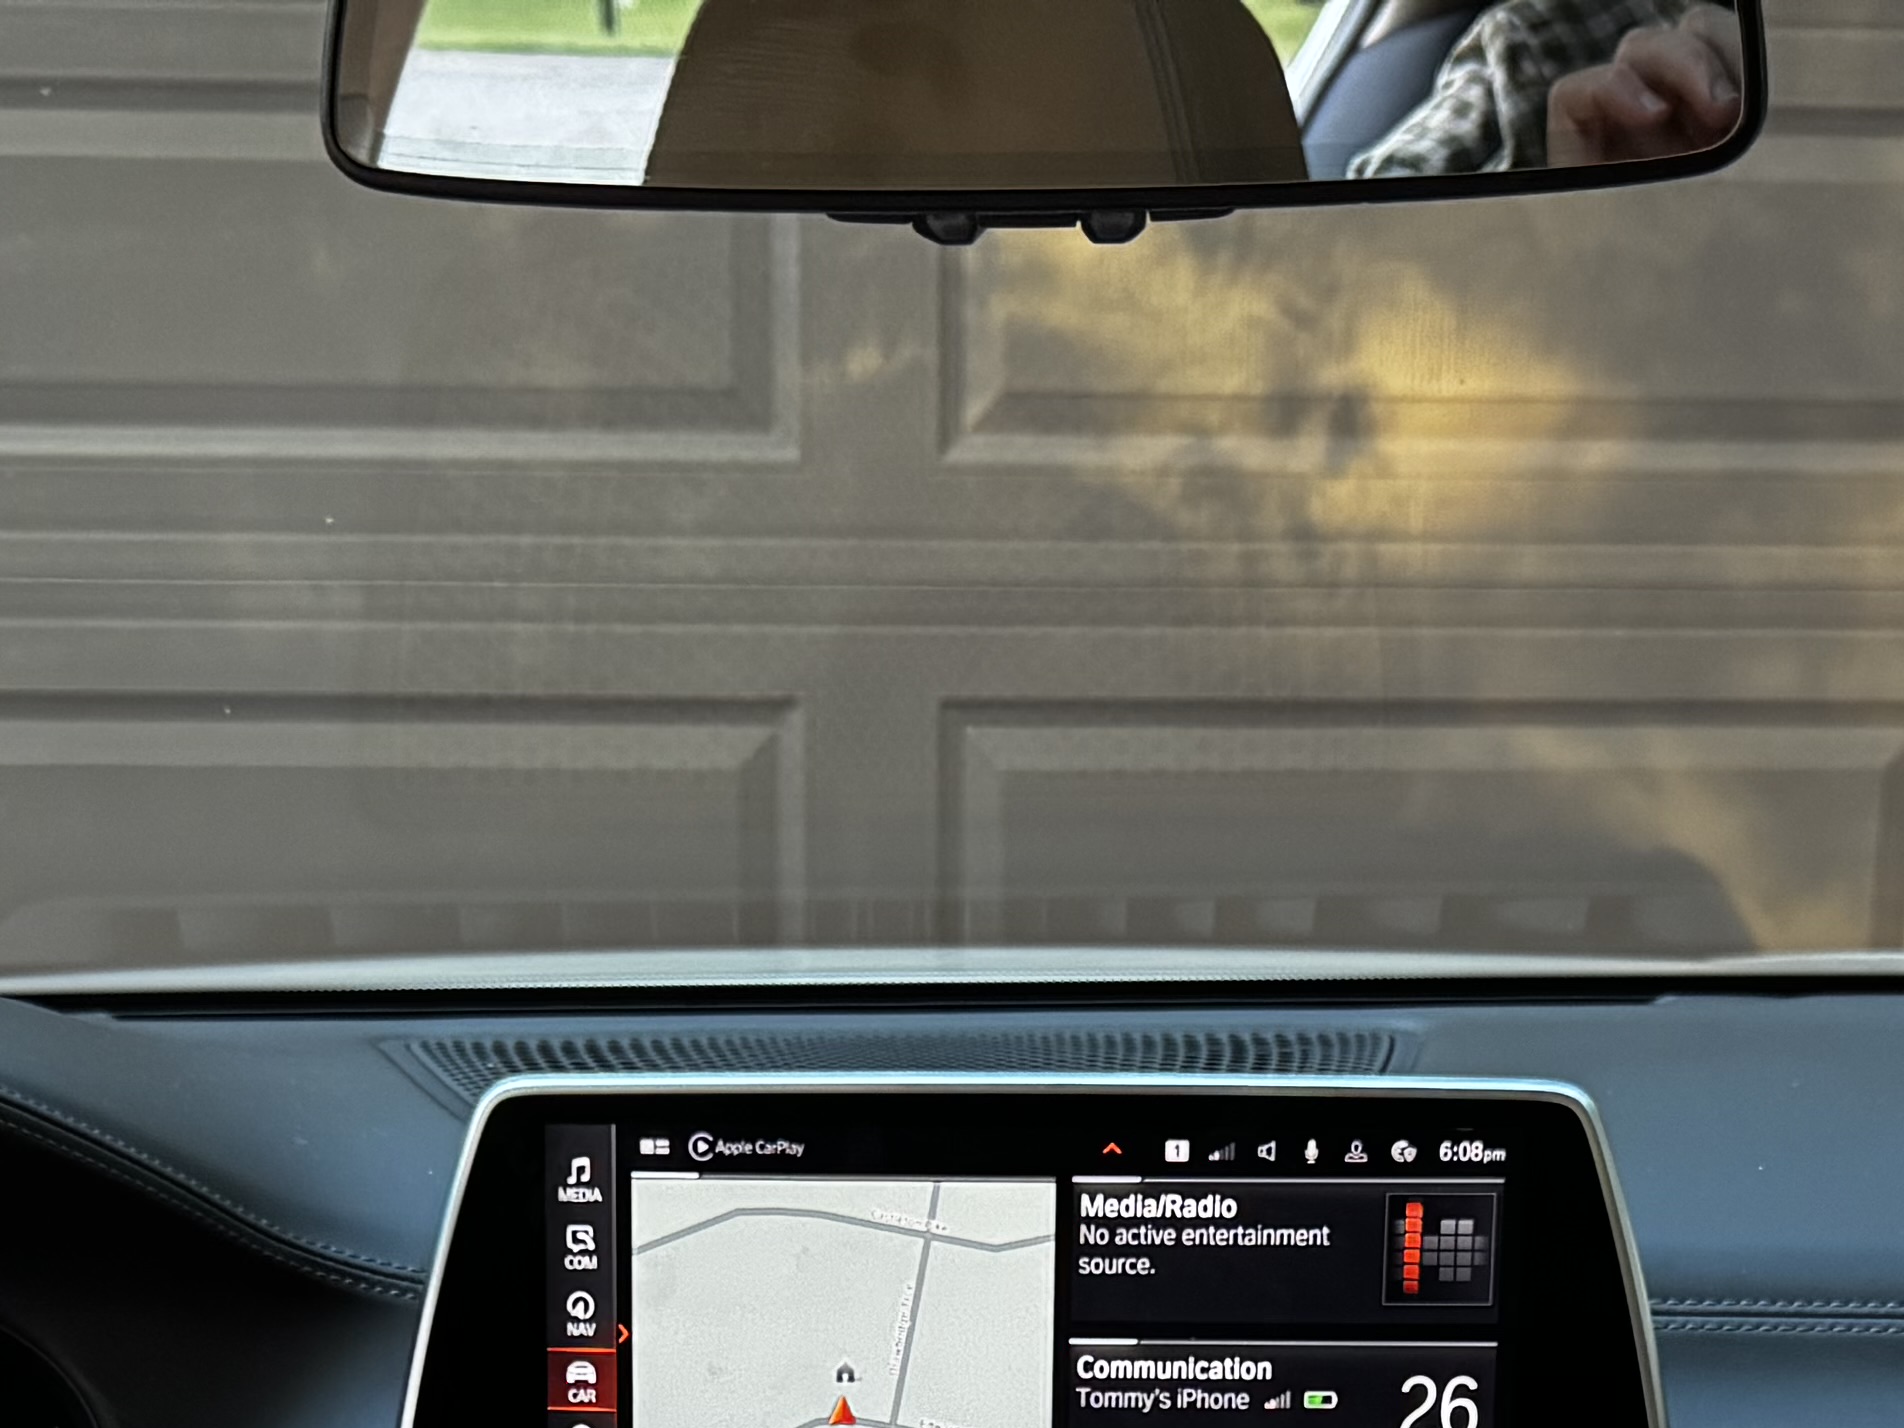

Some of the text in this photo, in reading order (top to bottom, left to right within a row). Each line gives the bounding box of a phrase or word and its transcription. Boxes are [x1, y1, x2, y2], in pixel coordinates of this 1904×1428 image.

[714, 1140, 805, 1158] Apple CarPlay
[557, 1186, 603, 1202] MEDIA
[1079, 1193, 1238, 1220] Media/Radio
[1078, 1224, 1331, 1248] No active entertainment
[564, 1255, 597, 1270] COM
[1078, 1255, 1156, 1276] source.
[566, 1322, 596, 1337] NAV
[1076, 1355, 1273, 1381] Communication
[567, 1388, 596, 1403] CAR
[1075, 1386, 1250, 1413] Tommy's iPhone
